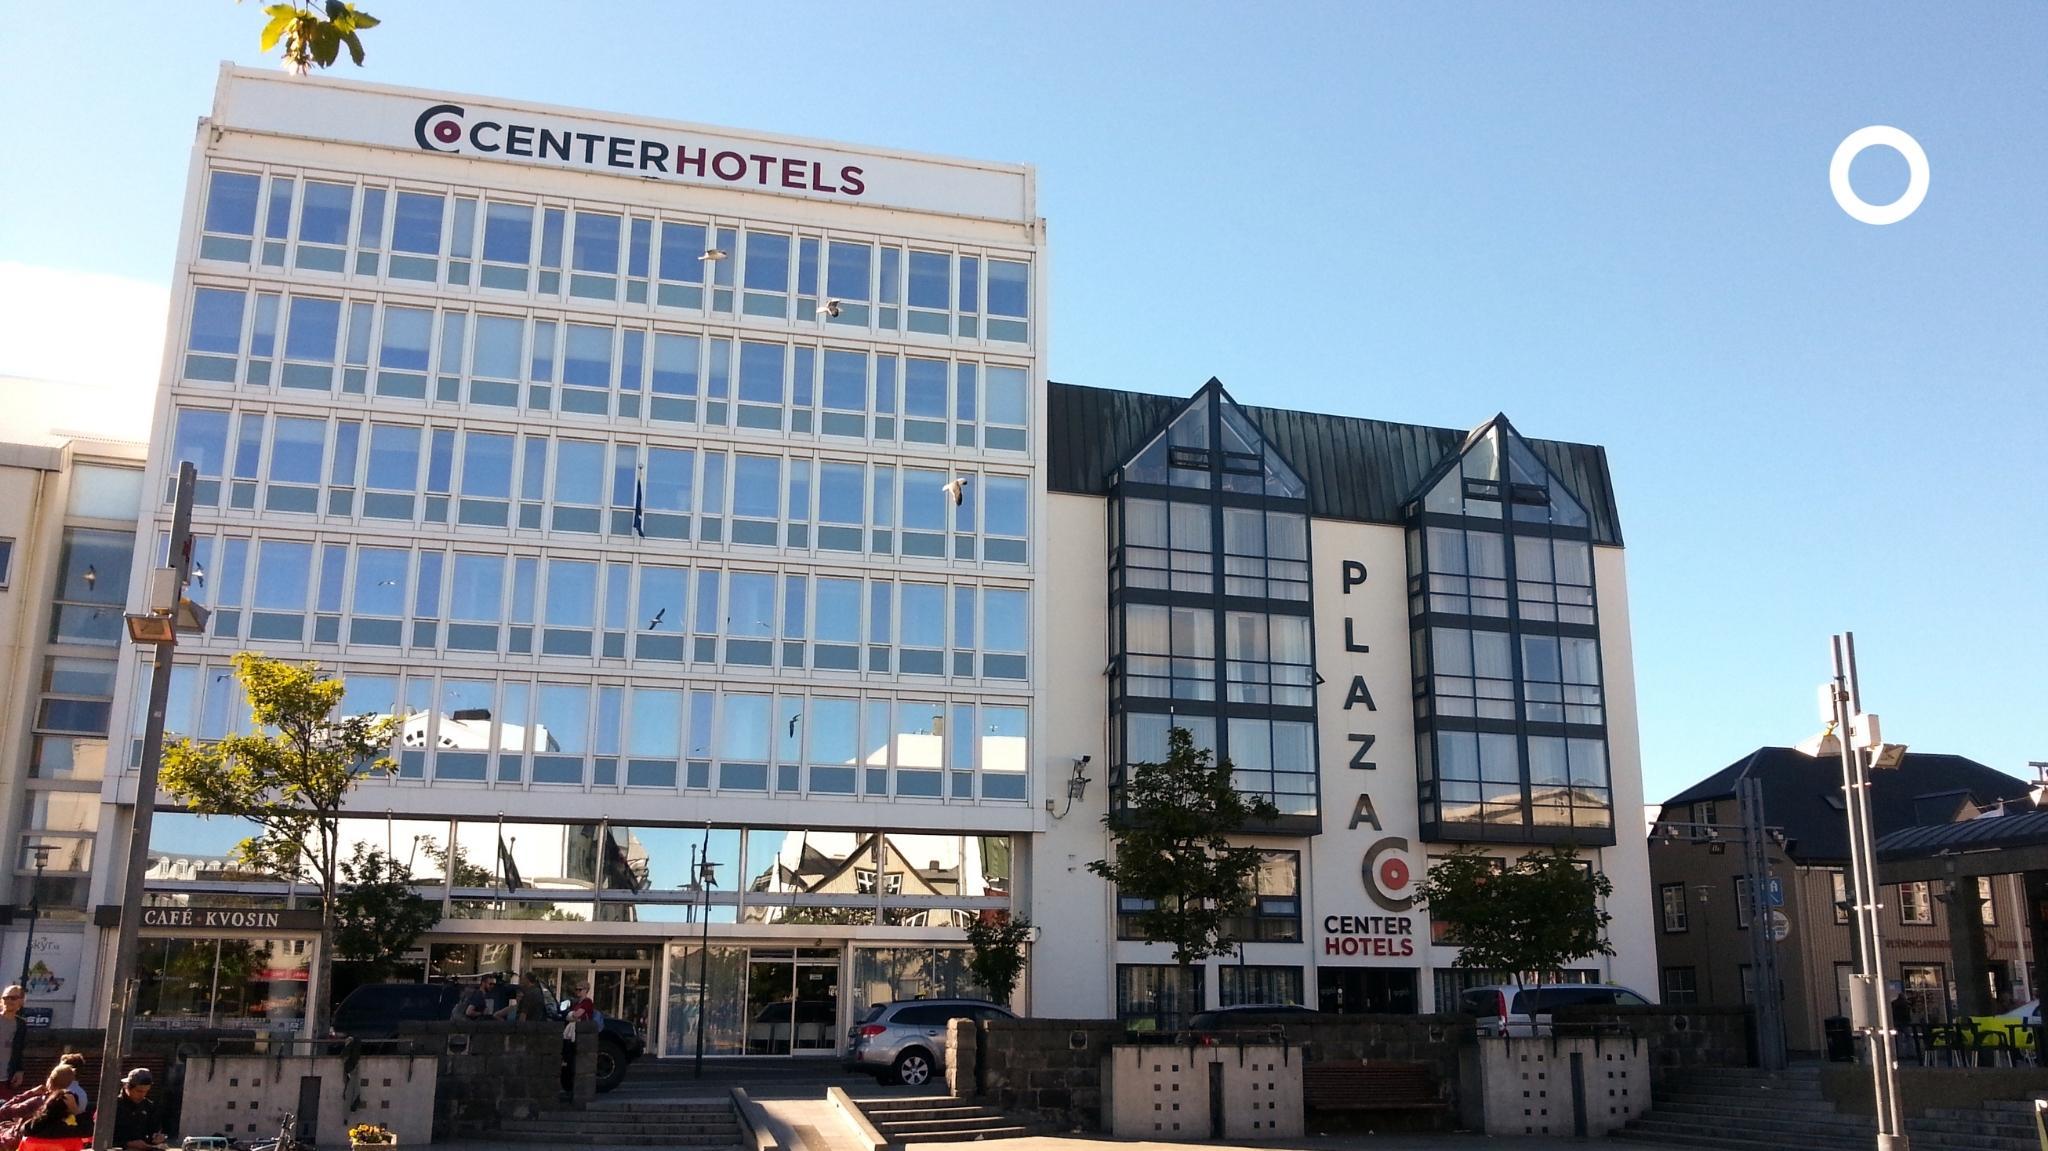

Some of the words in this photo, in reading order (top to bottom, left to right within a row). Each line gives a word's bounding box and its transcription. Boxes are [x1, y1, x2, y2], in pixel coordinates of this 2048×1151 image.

[469, 121, 865, 196] CENTERHOTELS
[1342, 560, 1382, 831] PLAZA
[144, 909, 193, 925] CAFÉ
[205, 911, 280, 927] KVOSIN
[1324, 915, 1412, 934] CENTER
[1325, 937, 1414, 956] HOTELS
